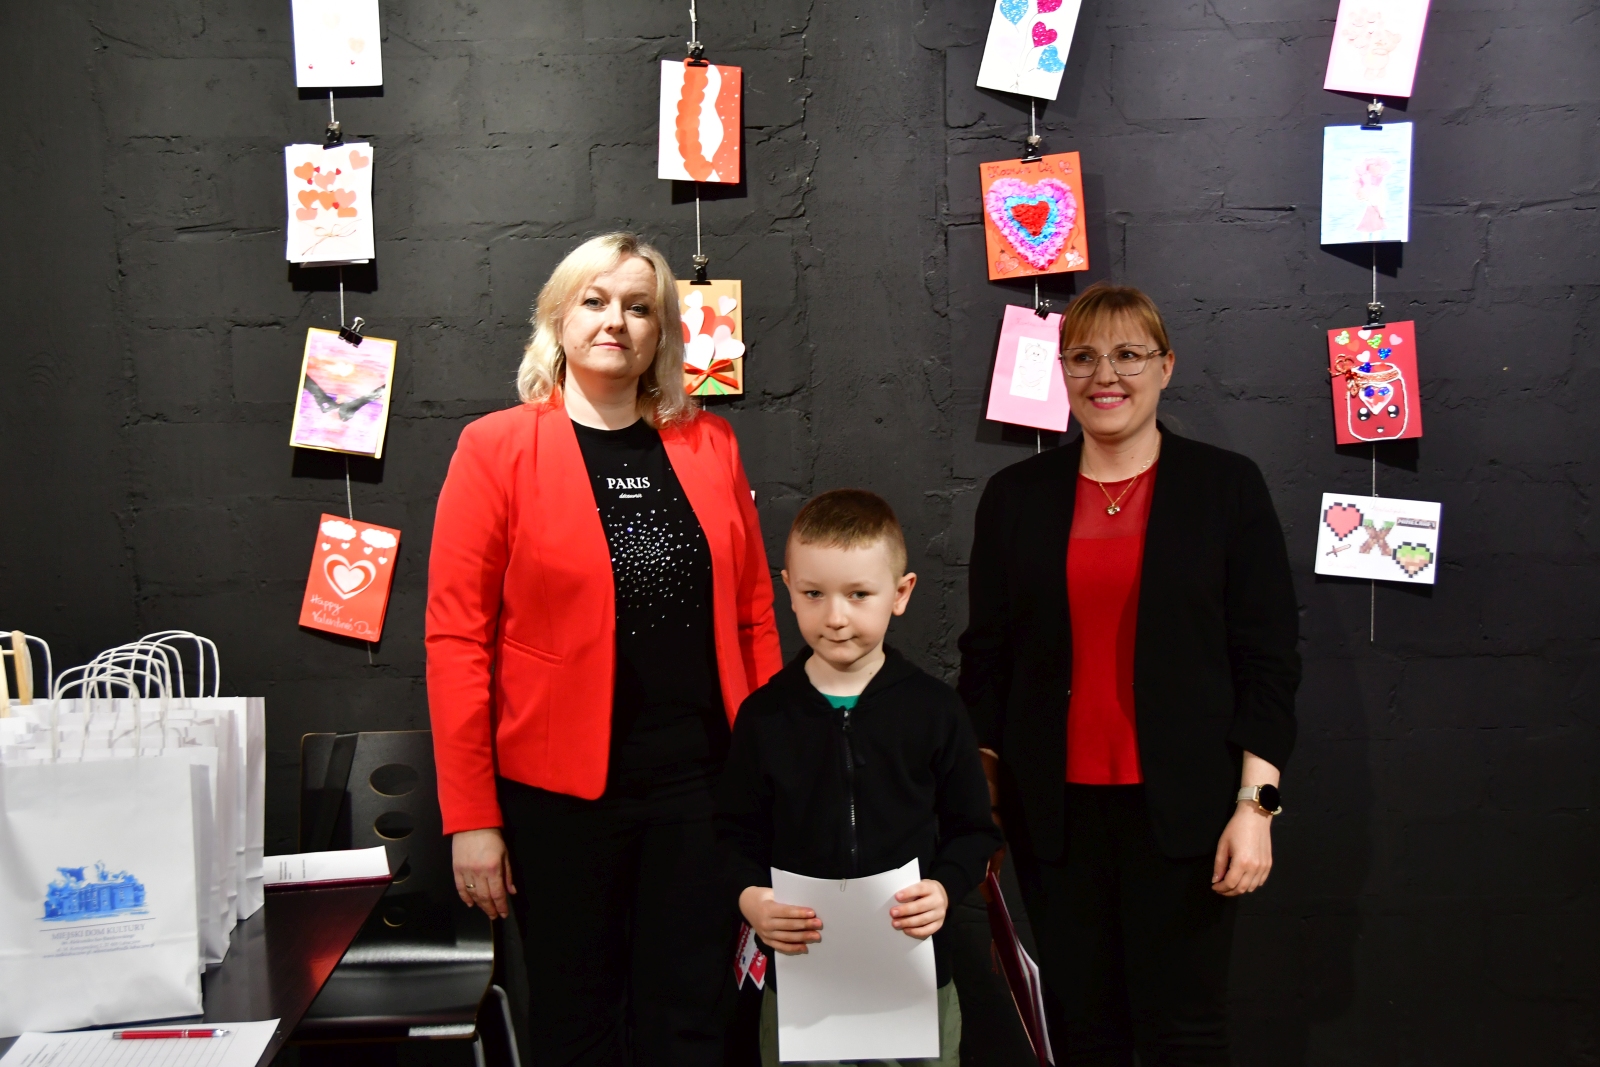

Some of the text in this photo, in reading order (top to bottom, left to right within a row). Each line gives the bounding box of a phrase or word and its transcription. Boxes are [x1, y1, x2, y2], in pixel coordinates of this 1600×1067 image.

[606, 476, 651, 489] PARIS
[310, 594, 344, 616] Happy
[52, 929, 84, 941] MIEJSKI
[85, 927, 105, 937] DOM
[107, 923, 146, 935] KULTURY
